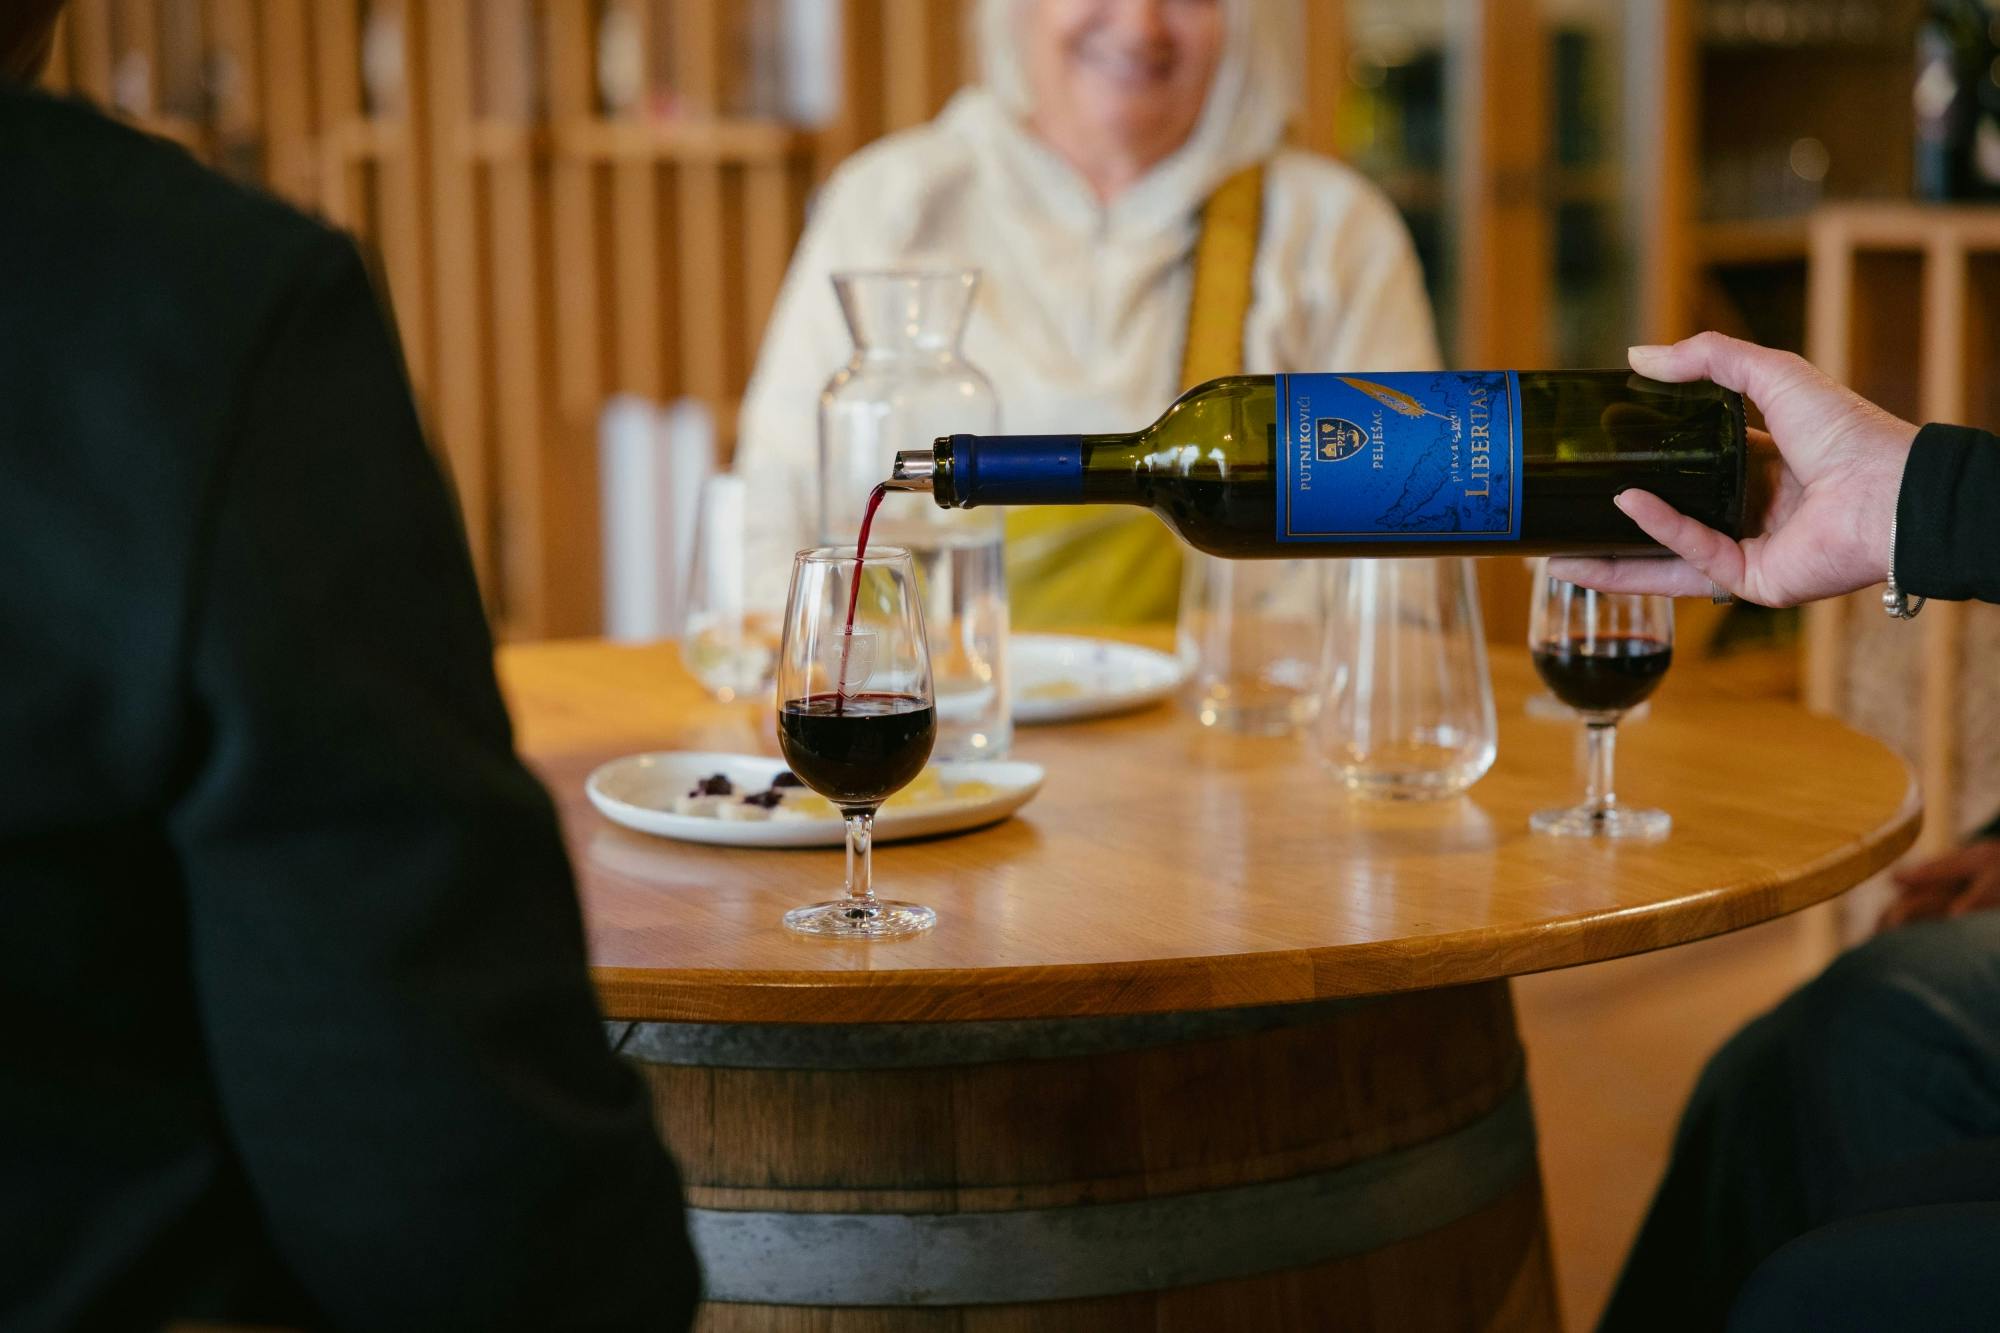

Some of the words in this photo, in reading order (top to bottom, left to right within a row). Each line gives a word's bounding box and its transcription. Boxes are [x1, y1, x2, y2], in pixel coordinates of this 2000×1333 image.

[1297, 395, 1311, 491] PUTNIKOVIĆI
[1371, 409, 1384, 470] PELJEŠAC
[1465, 387, 1490, 498] LIBERTAS
